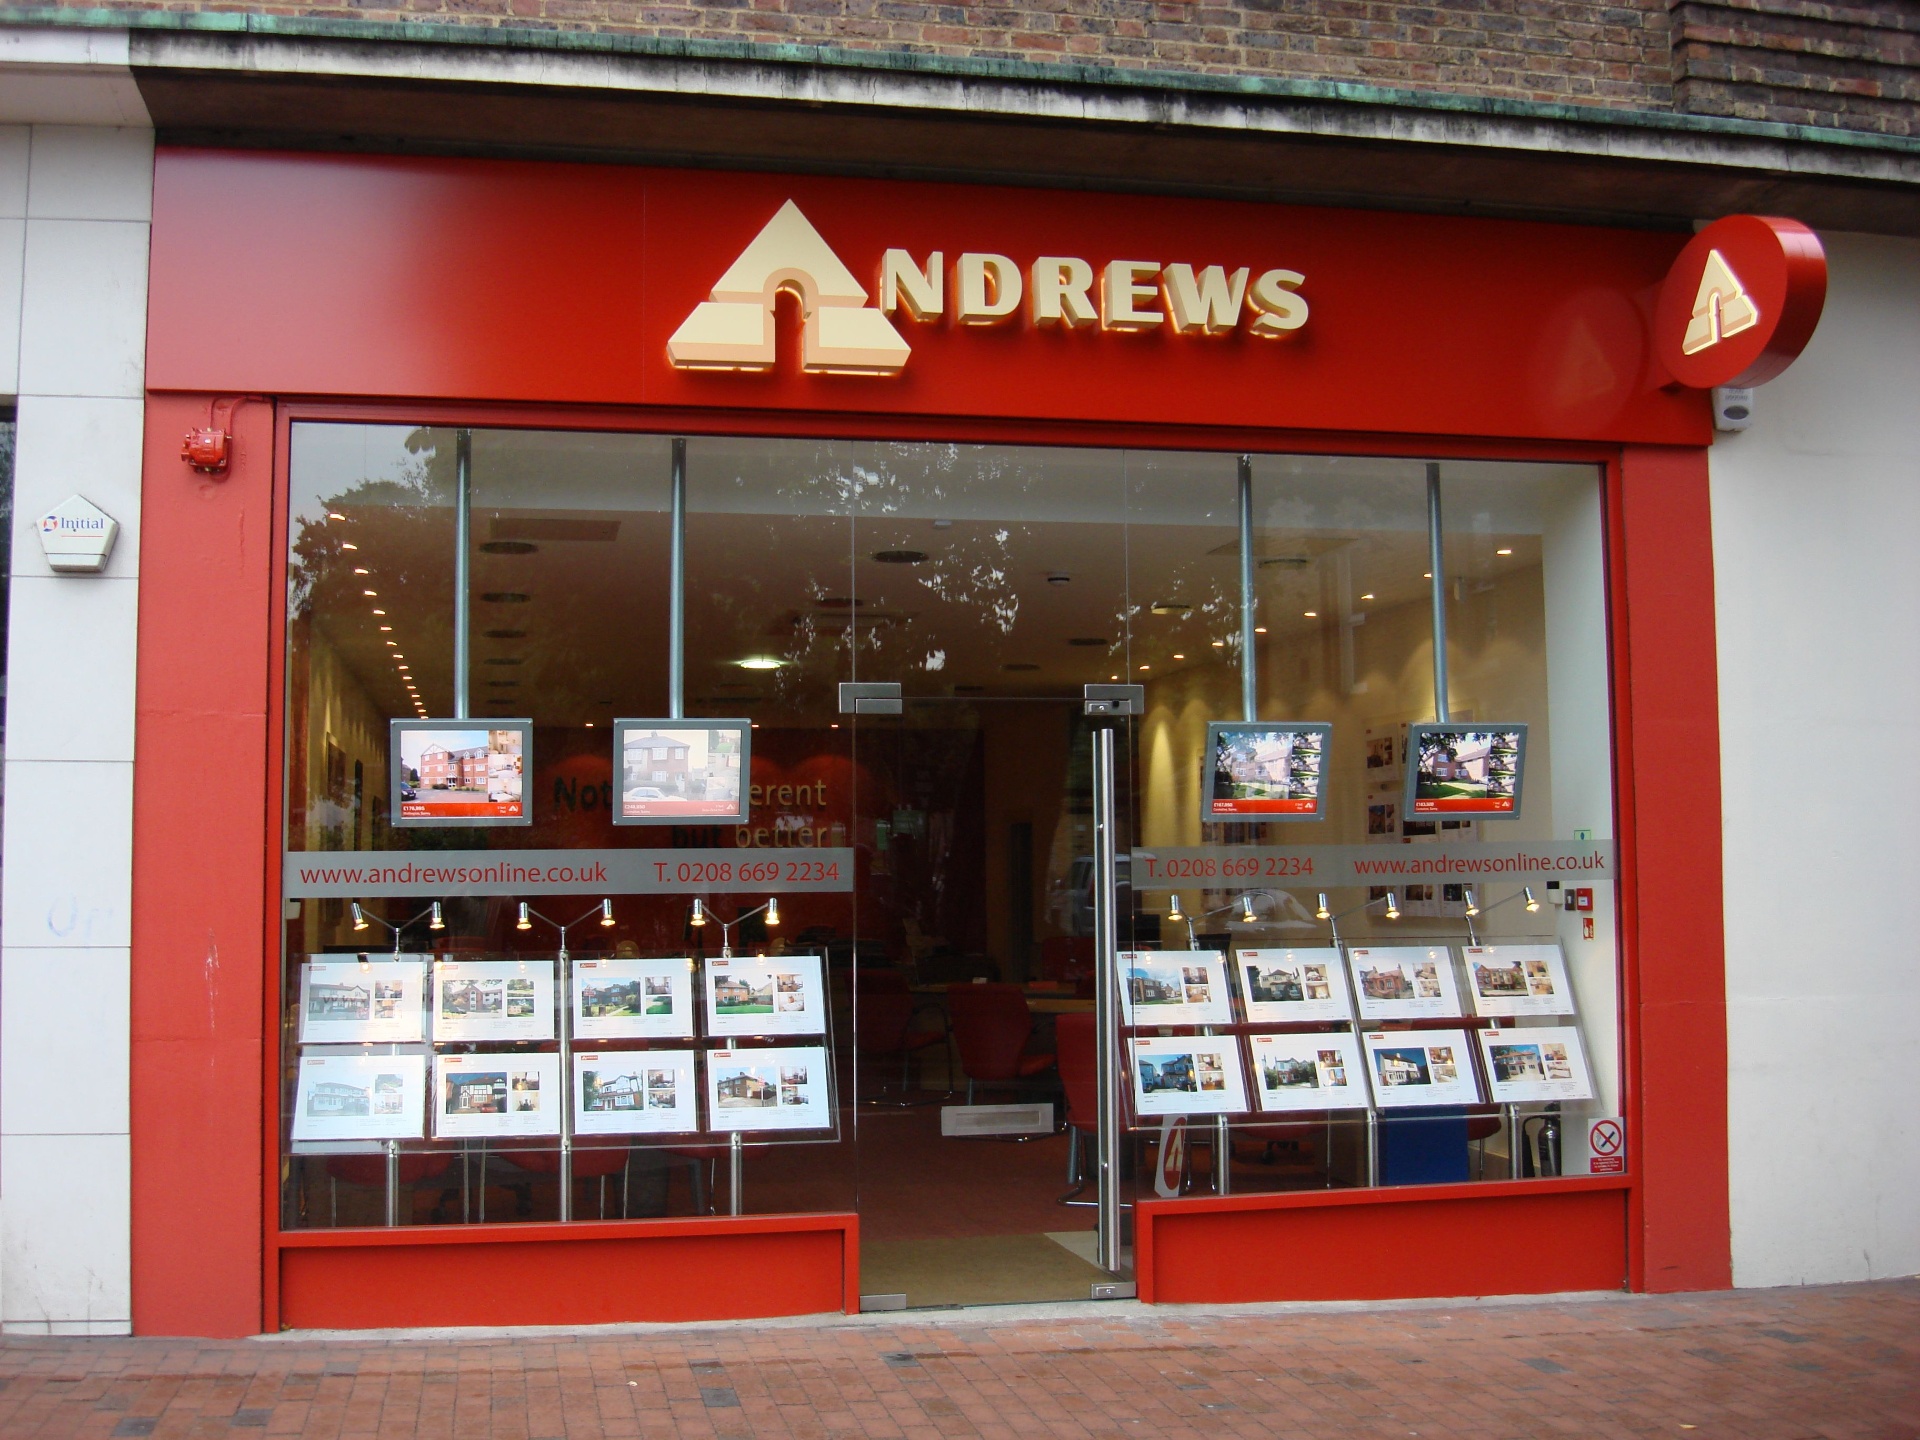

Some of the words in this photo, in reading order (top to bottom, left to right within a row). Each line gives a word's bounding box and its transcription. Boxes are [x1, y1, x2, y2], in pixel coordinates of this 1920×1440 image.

[667, 198, 1310, 377] ANDREWS
[60, 517, 104, 530] Initial
[749, 778, 828, 807] erent
[735, 823, 827, 849] better
[300, 861, 608, 884] www.andrewsonline.co.uk
[653, 862, 672, 883] T.
[677, 862, 732, 883] 0208
[738, 862, 780, 882] 669
[785, 861, 840, 882] 2234
[1145, 858, 1163, 878] T.
[1166, 858, 1217, 878] 0208
[1222, 857, 1260, 877] 669
[1265, 857, 1314, 876] 2234
[1353, 850, 1605, 875] www.andrewsonline.co.uk
